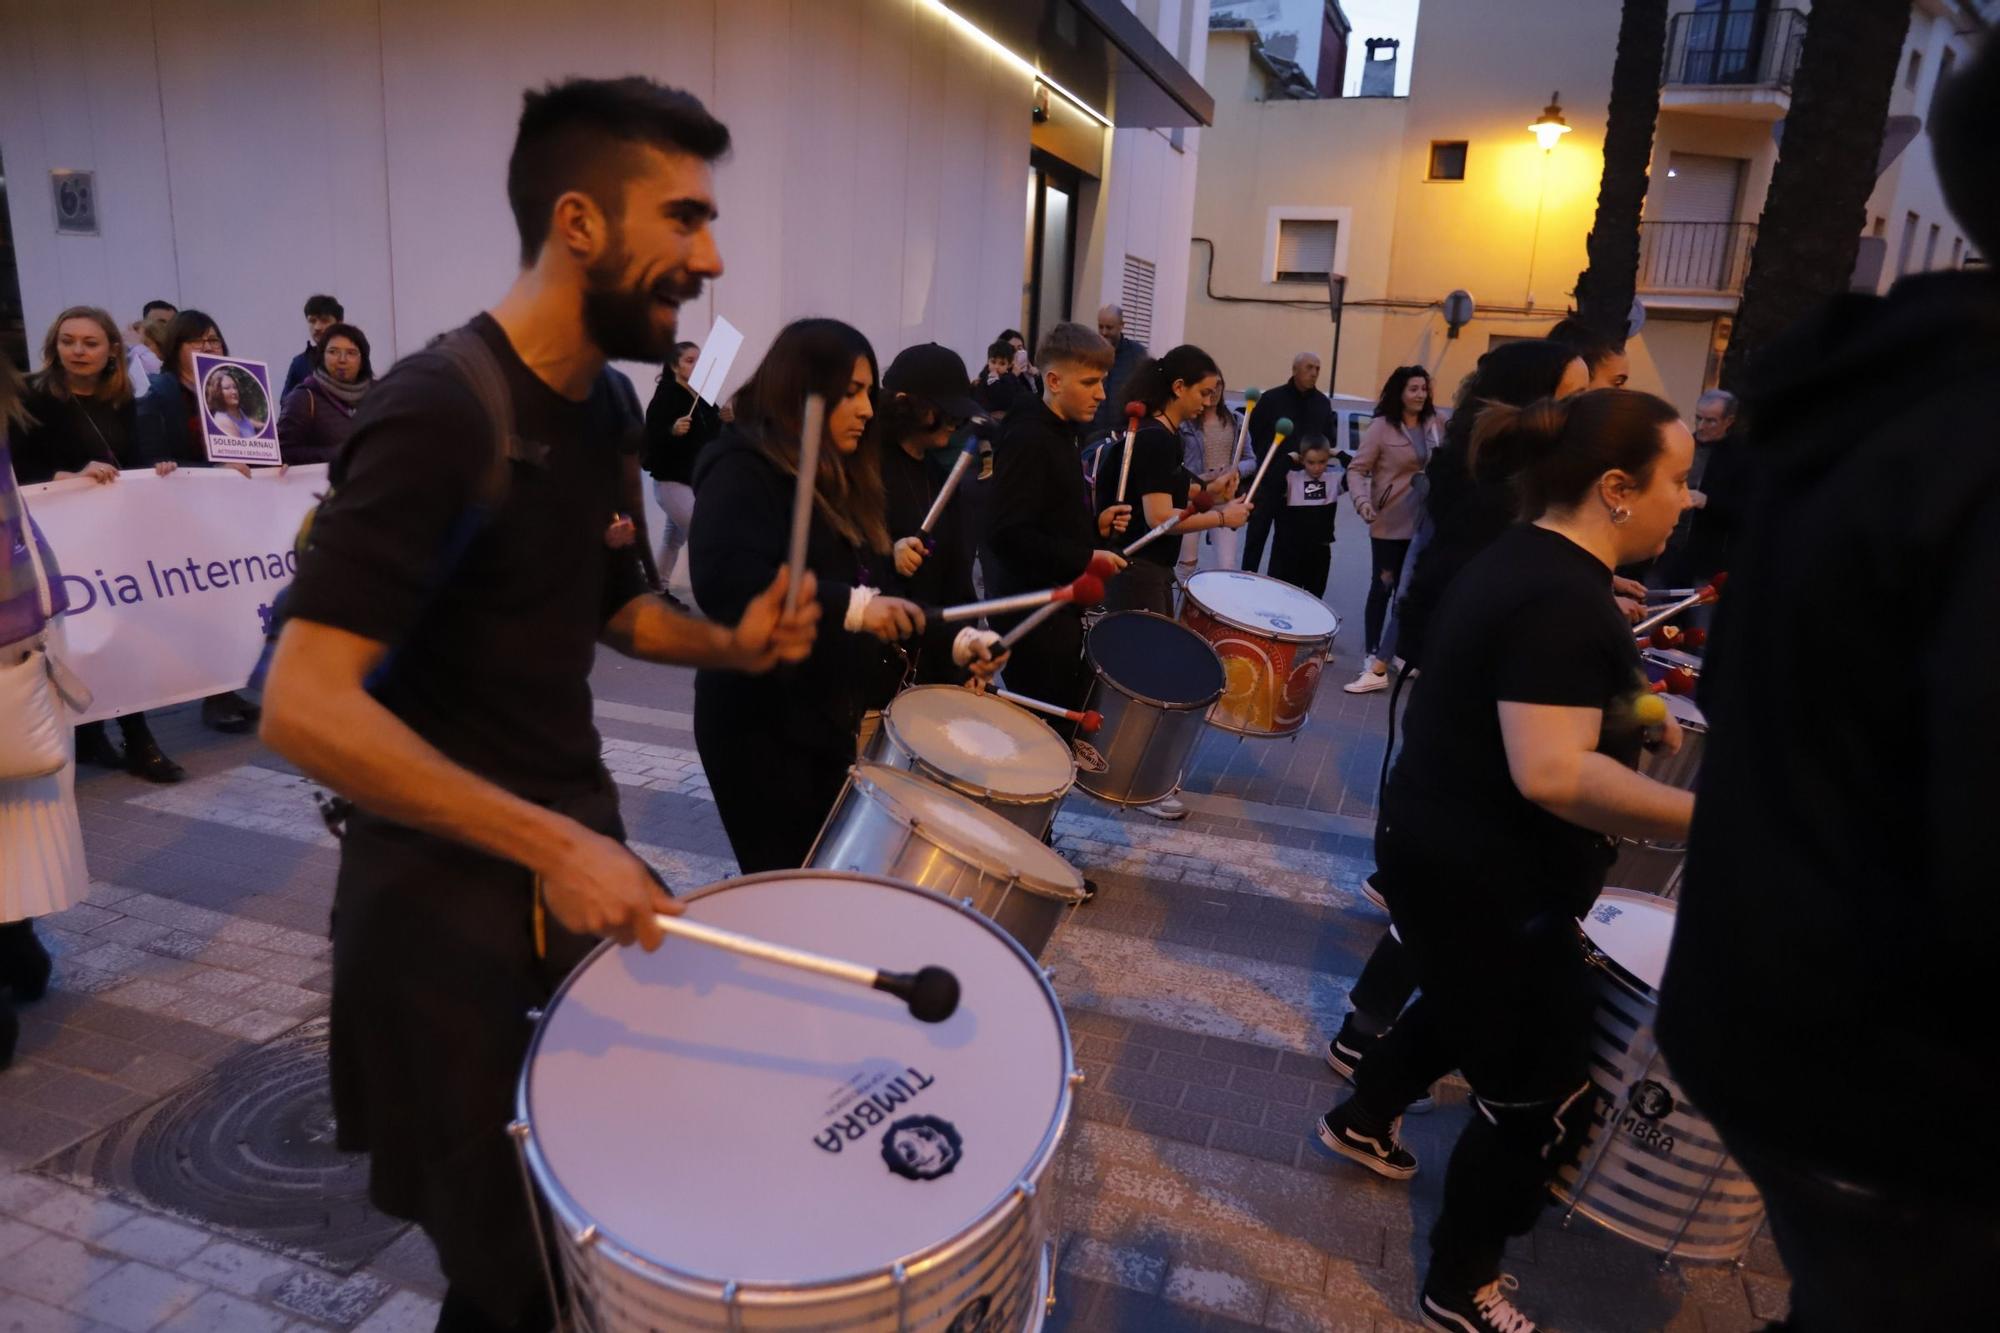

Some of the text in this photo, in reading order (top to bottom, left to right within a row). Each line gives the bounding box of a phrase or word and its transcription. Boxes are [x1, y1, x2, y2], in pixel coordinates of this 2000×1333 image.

[213, 438, 274, 449] SOLEDAD ARNAU
[61, 569, 143, 617] Dia
[813, 1067, 935, 1153] TIMBRA
[1601, 1099, 1675, 1153] TIMBRA
